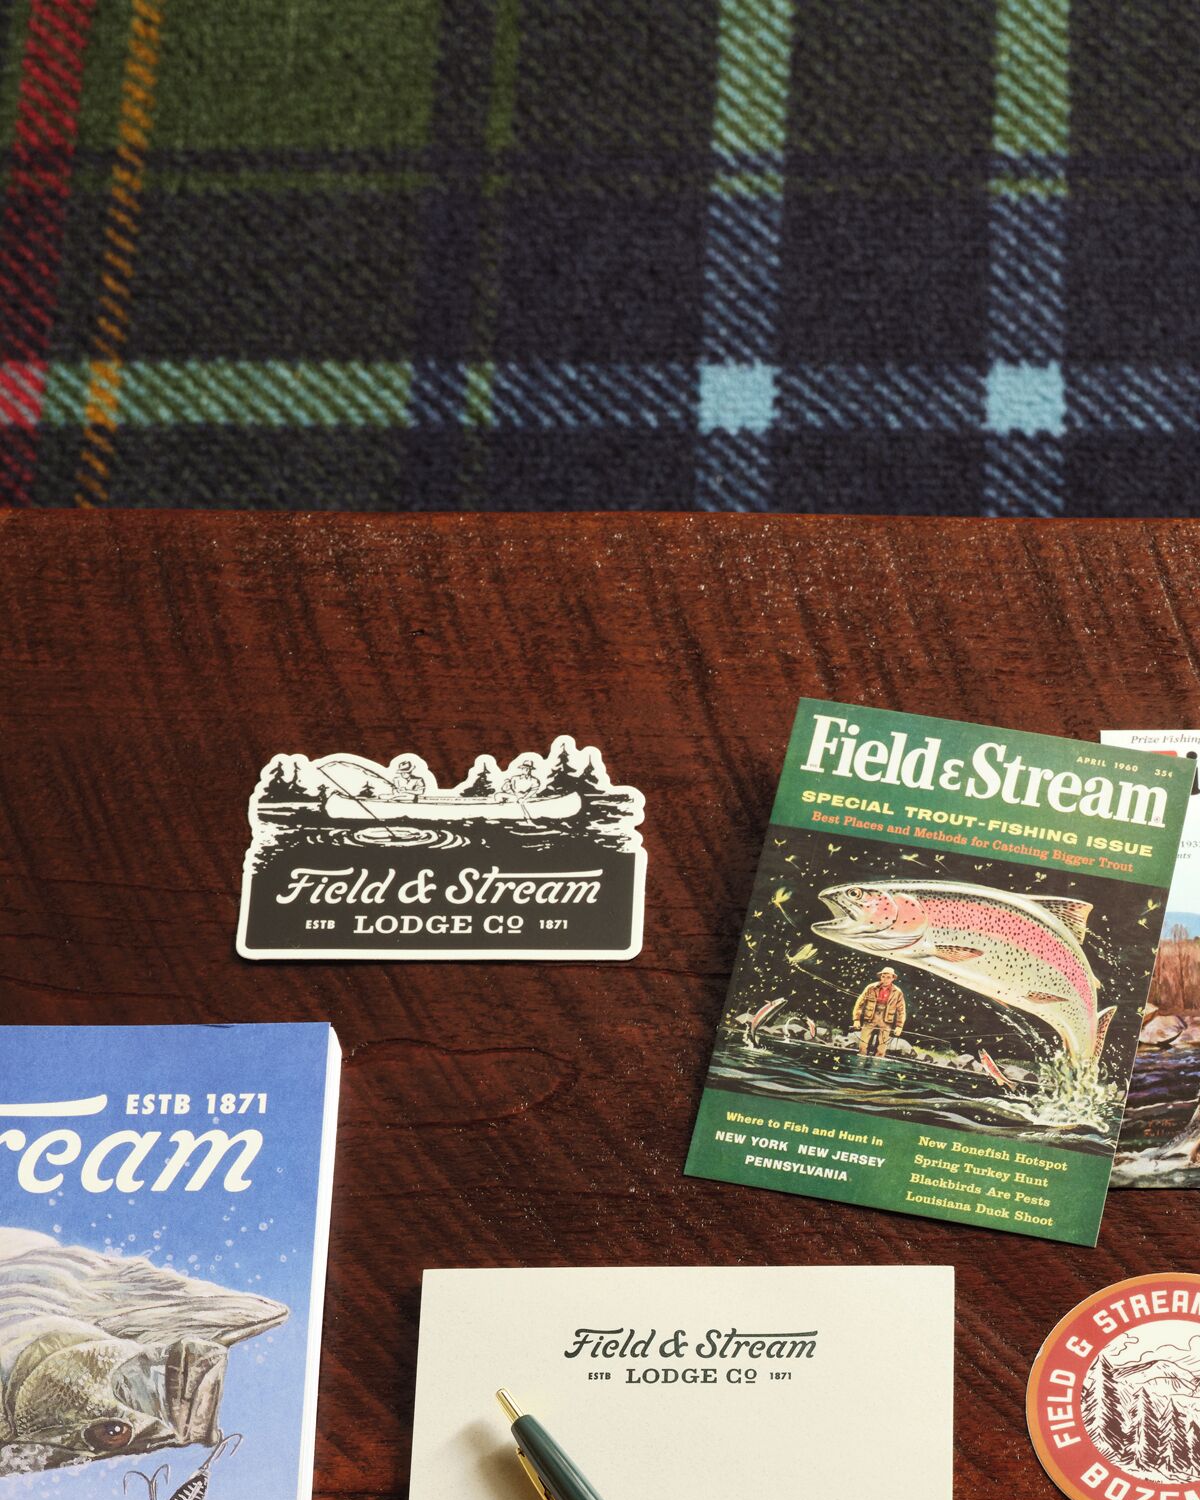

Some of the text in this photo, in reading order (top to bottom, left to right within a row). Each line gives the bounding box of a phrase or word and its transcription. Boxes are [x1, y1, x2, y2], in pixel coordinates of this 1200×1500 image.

[1130, 735, 1159, 745] Prize
[800, 714, 941, 791] Field
[965, 742, 1168, 828] Stream
[1076, 756, 1138, 772] APRIL 1960
[801, 789, 1153, 858] SPECIAL TROUT-FISHING ISSUE
[812, 811, 1134, 873] Best Places and Methods for Catching Bigger Trout
[276, 867, 603, 905] Field & Stream
[305, 919, 336, 930] ESTB
[353, 915, 473, 934] LODGE
[539, 919, 568, 930] 1871
[126, 1093, 267, 1114] ESTB 1871
[726, 1111, 884, 1147] Where to Fish and Hunt in
[715, 1130, 886, 1168] NEW YORK NEW JERSEY
[918, 1135, 1068, 1173] New Bonefish Hotspot
[744, 1155, 849, 1182] PENNSYLVANIA
[913, 1153, 1049, 1188] Spring Turkey Hunt
[909, 1172, 1051, 1208] Blackbirds Are Pests
[905, 1190, 1054, 1227] Louisiana Duck Shoot
[563, 1327, 818, 1359] Field & Stream
[588, 1372, 612, 1381] ESTB
[625, 1368, 718, 1384] LODGE
[769, 1371, 793, 1381] 1871
[1047, 1368, 1081, 1449] FIELD
[1065, 1335, 1094, 1359] &
